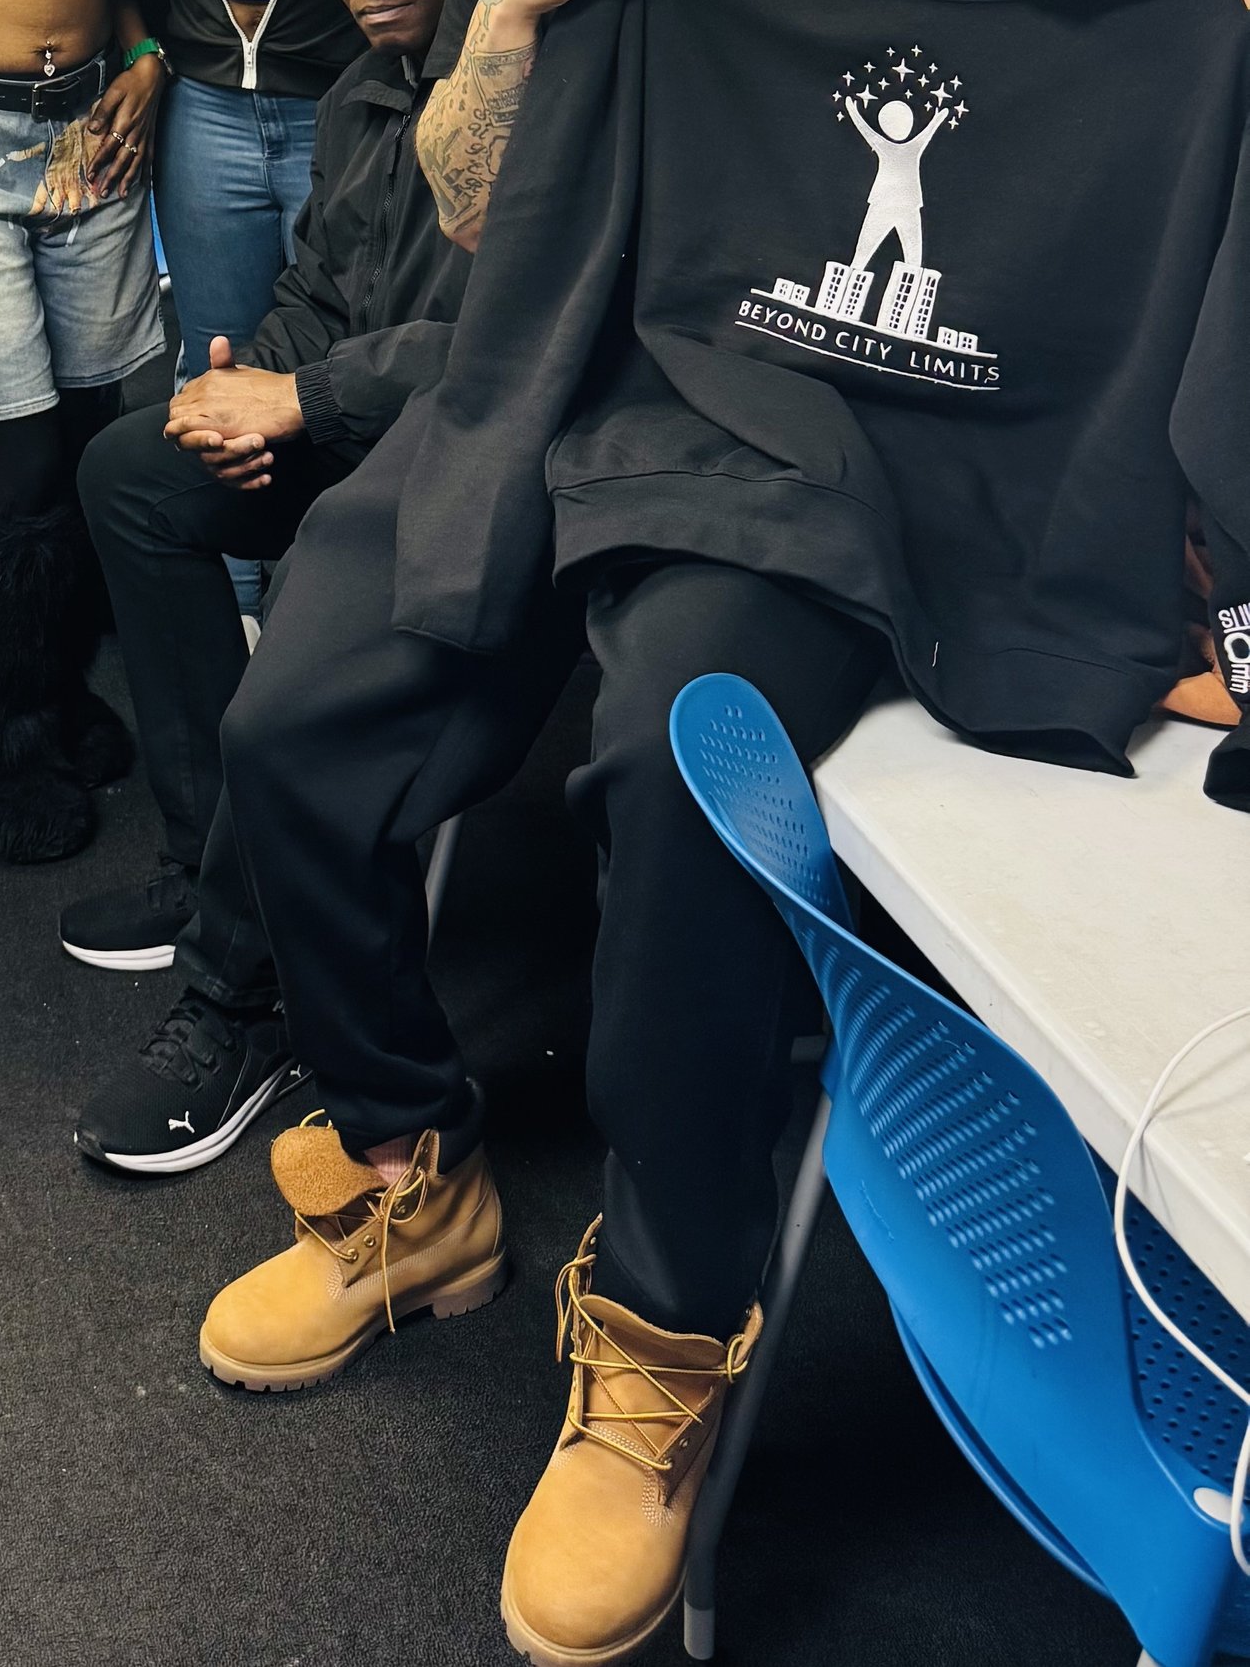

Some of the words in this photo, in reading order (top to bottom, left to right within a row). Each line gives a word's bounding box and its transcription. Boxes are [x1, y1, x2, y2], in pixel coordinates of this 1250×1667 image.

[738, 300, 827, 341] BEYOND
[835, 331, 893, 360] CITY
[909, 351, 1001, 384] LIMITS
